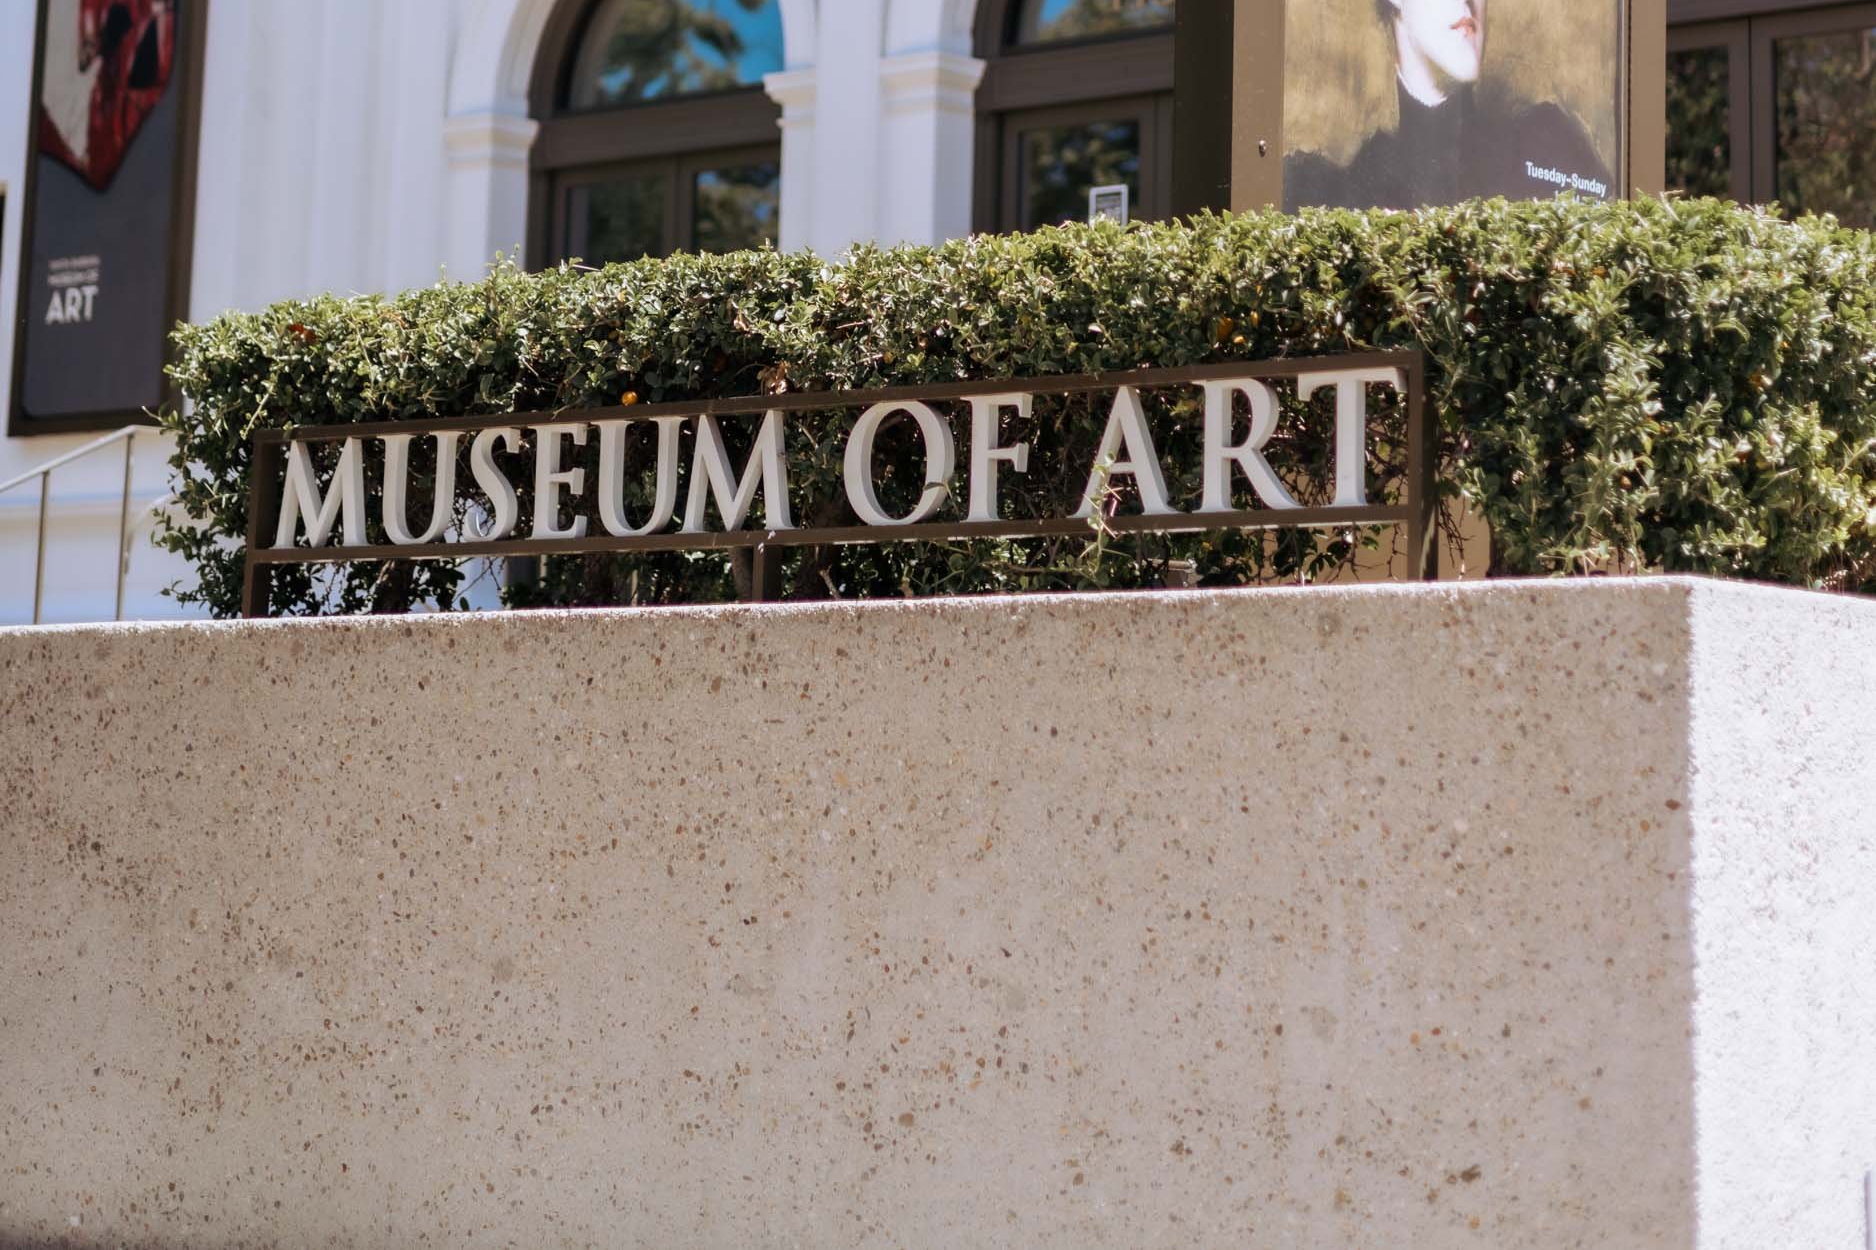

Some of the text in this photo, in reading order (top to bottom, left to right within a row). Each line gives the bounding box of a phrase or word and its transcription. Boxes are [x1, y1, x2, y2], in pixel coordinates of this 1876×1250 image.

[45, 284, 99, 325] ART
[272, 366, 1404, 550] MUSEUM OF ART
